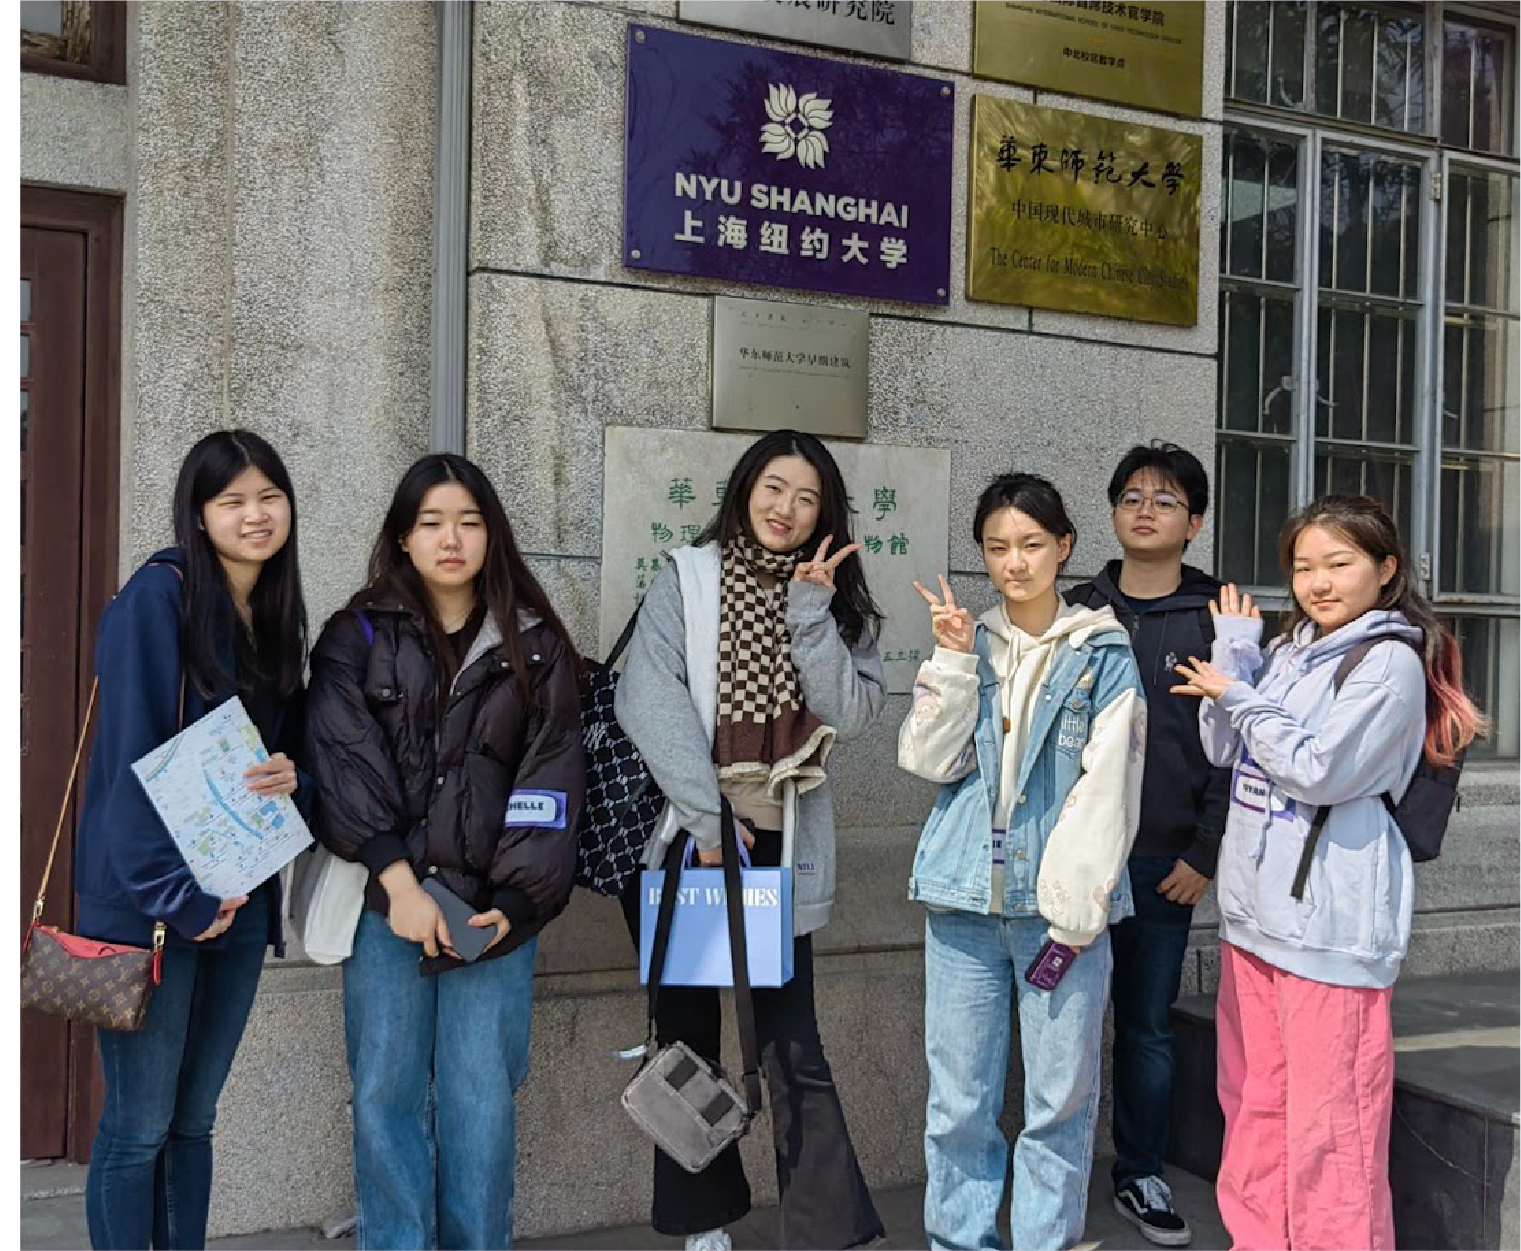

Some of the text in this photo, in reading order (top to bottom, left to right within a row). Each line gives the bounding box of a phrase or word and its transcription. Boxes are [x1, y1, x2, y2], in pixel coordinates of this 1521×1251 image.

[675, 172, 908, 229] NYU SHANGHAI
[1011, 199, 1169, 240] 中国现代城市研究中心
[674, 209, 908, 269] 上海纽约大学
[991, 247, 1007, 266] The
[1012, 250, 1041, 271] Center
[1046, 254, 1060, 273] for
[1065, 255, 1097, 278] Modern
